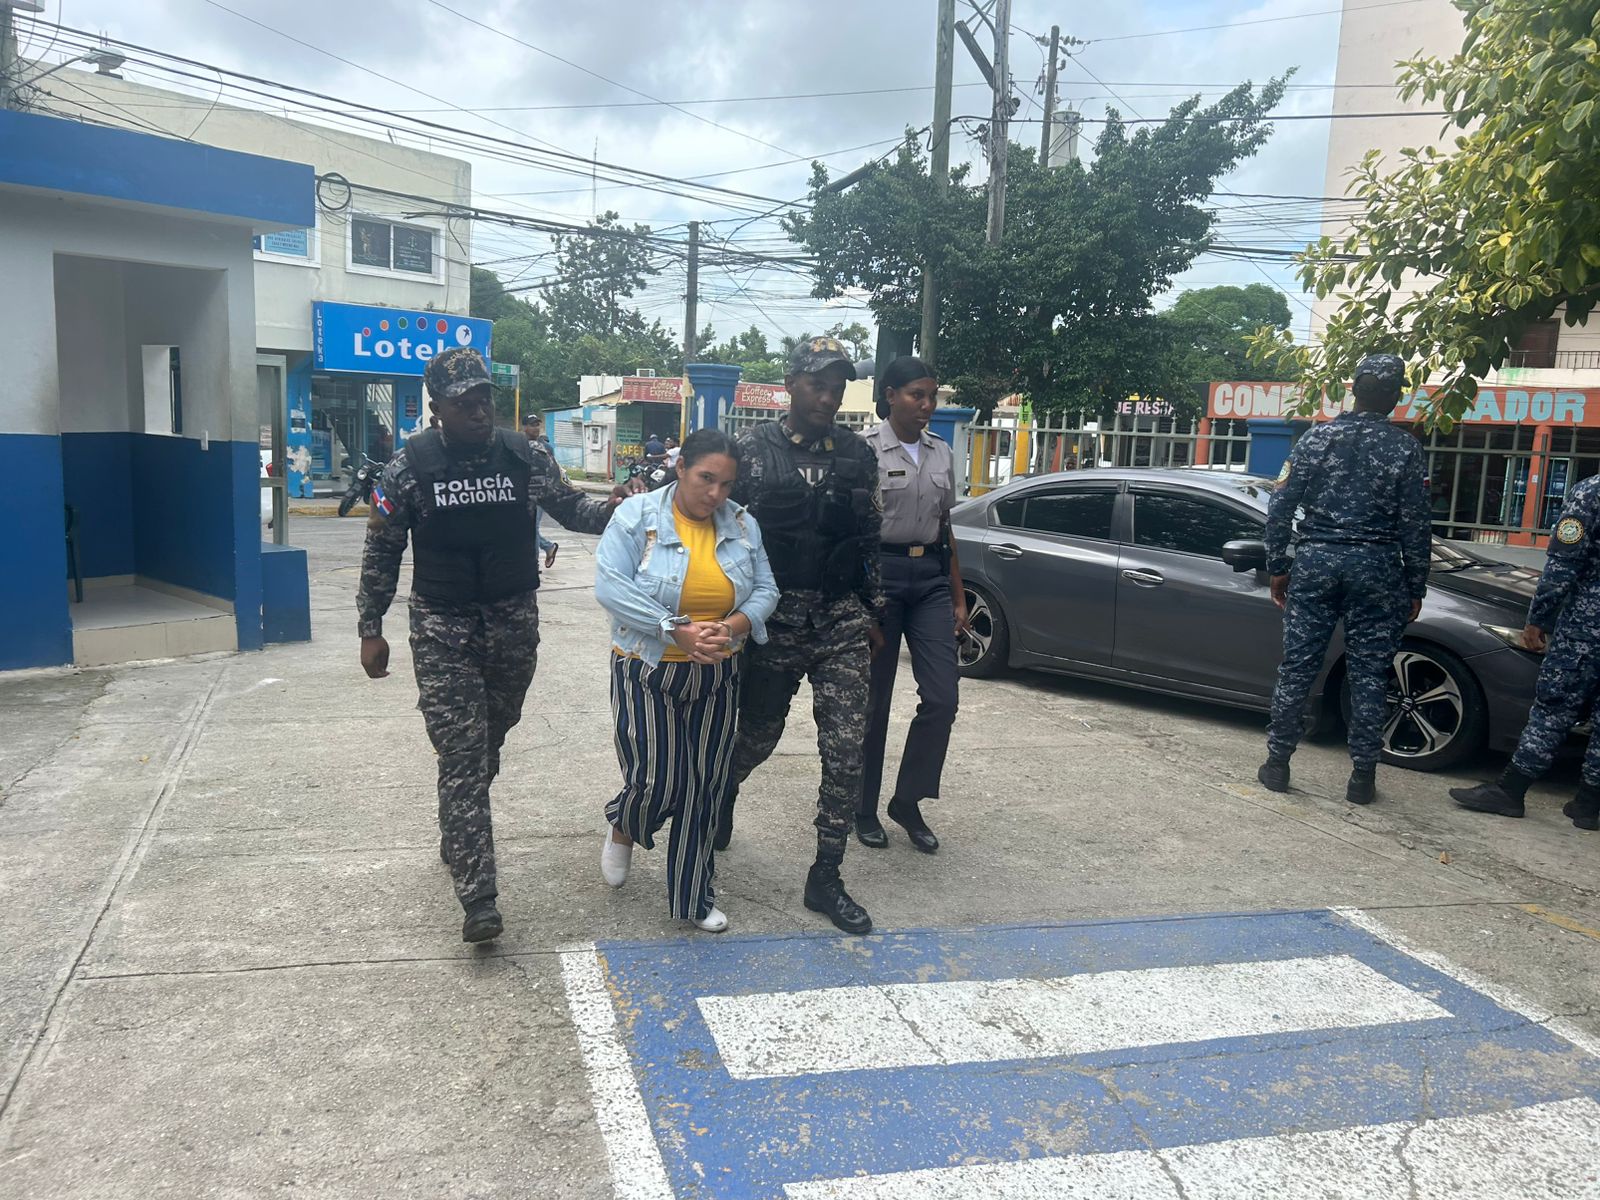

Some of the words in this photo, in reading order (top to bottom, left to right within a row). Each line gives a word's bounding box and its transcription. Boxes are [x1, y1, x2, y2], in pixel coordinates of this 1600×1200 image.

[745, 384, 770, 396] Coffee
[741, 391, 771, 406] Express
[433, 473, 514, 494] POLICÍA
[435, 489, 516, 507] NACIONAL
